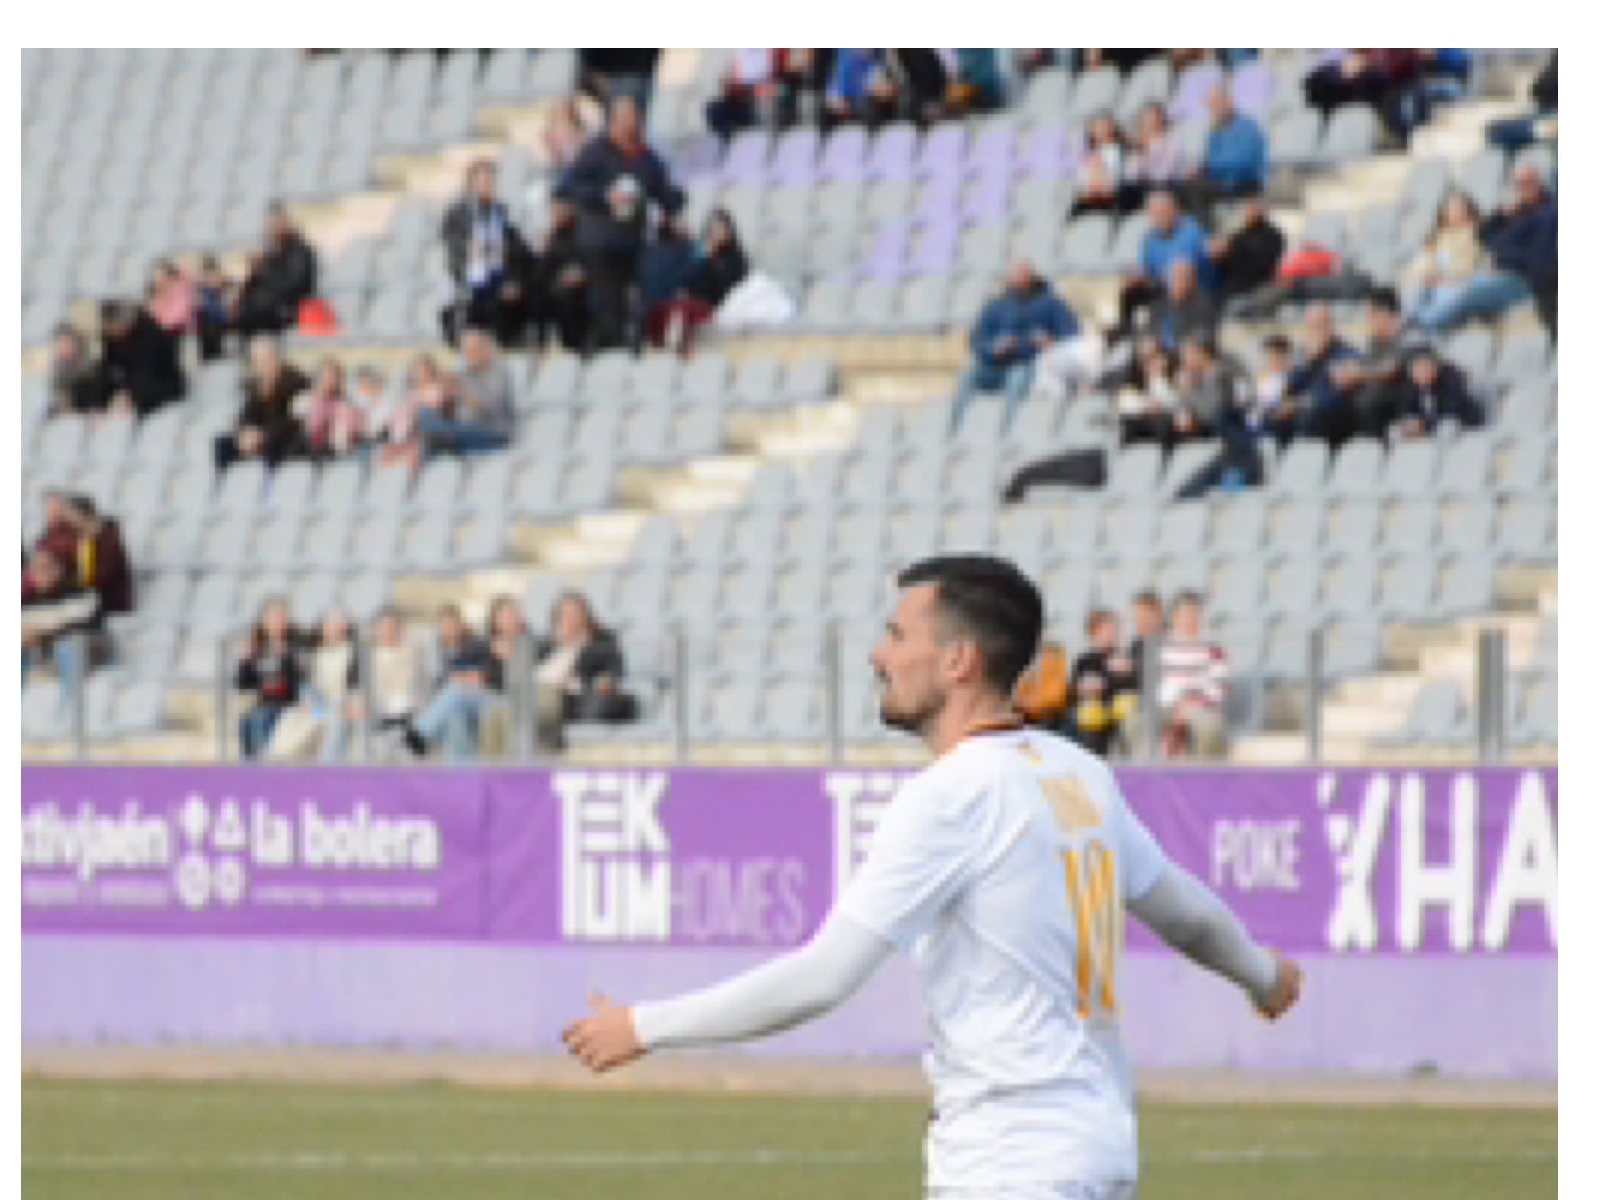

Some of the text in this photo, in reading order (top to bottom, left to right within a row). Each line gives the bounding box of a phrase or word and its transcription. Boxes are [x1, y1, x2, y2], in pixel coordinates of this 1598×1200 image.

[252, 798, 439, 868] la bolera
[1214, 818, 1300, 890] POKE
[672, 857, 808, 942] HOMES
